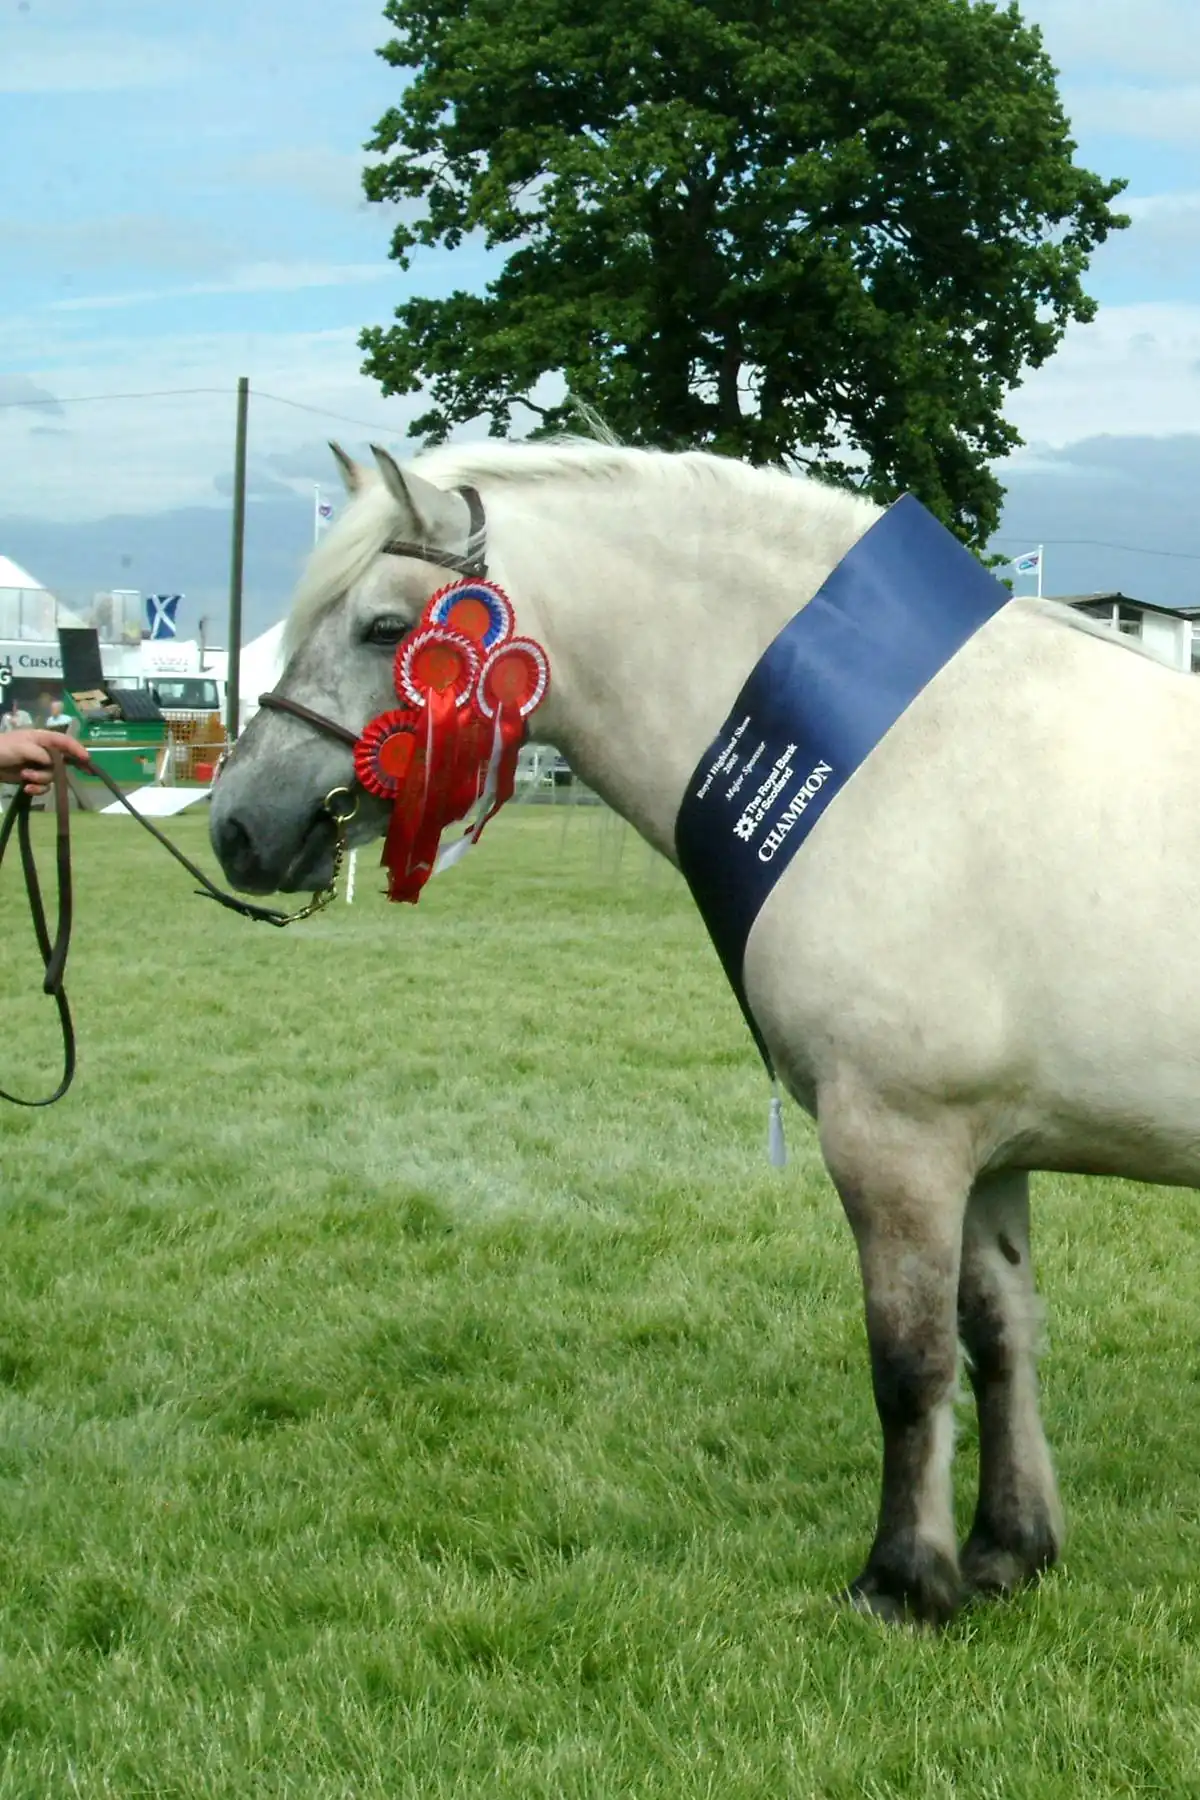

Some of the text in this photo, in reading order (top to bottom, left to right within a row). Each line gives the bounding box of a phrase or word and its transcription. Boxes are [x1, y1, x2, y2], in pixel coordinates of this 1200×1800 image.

[696, 716, 751, 799] Royal Highland Show
[745, 743, 798, 813] The Royal Bank
[755, 766, 794, 821] of Scotland
[758, 760, 833, 862] CHAMPION
